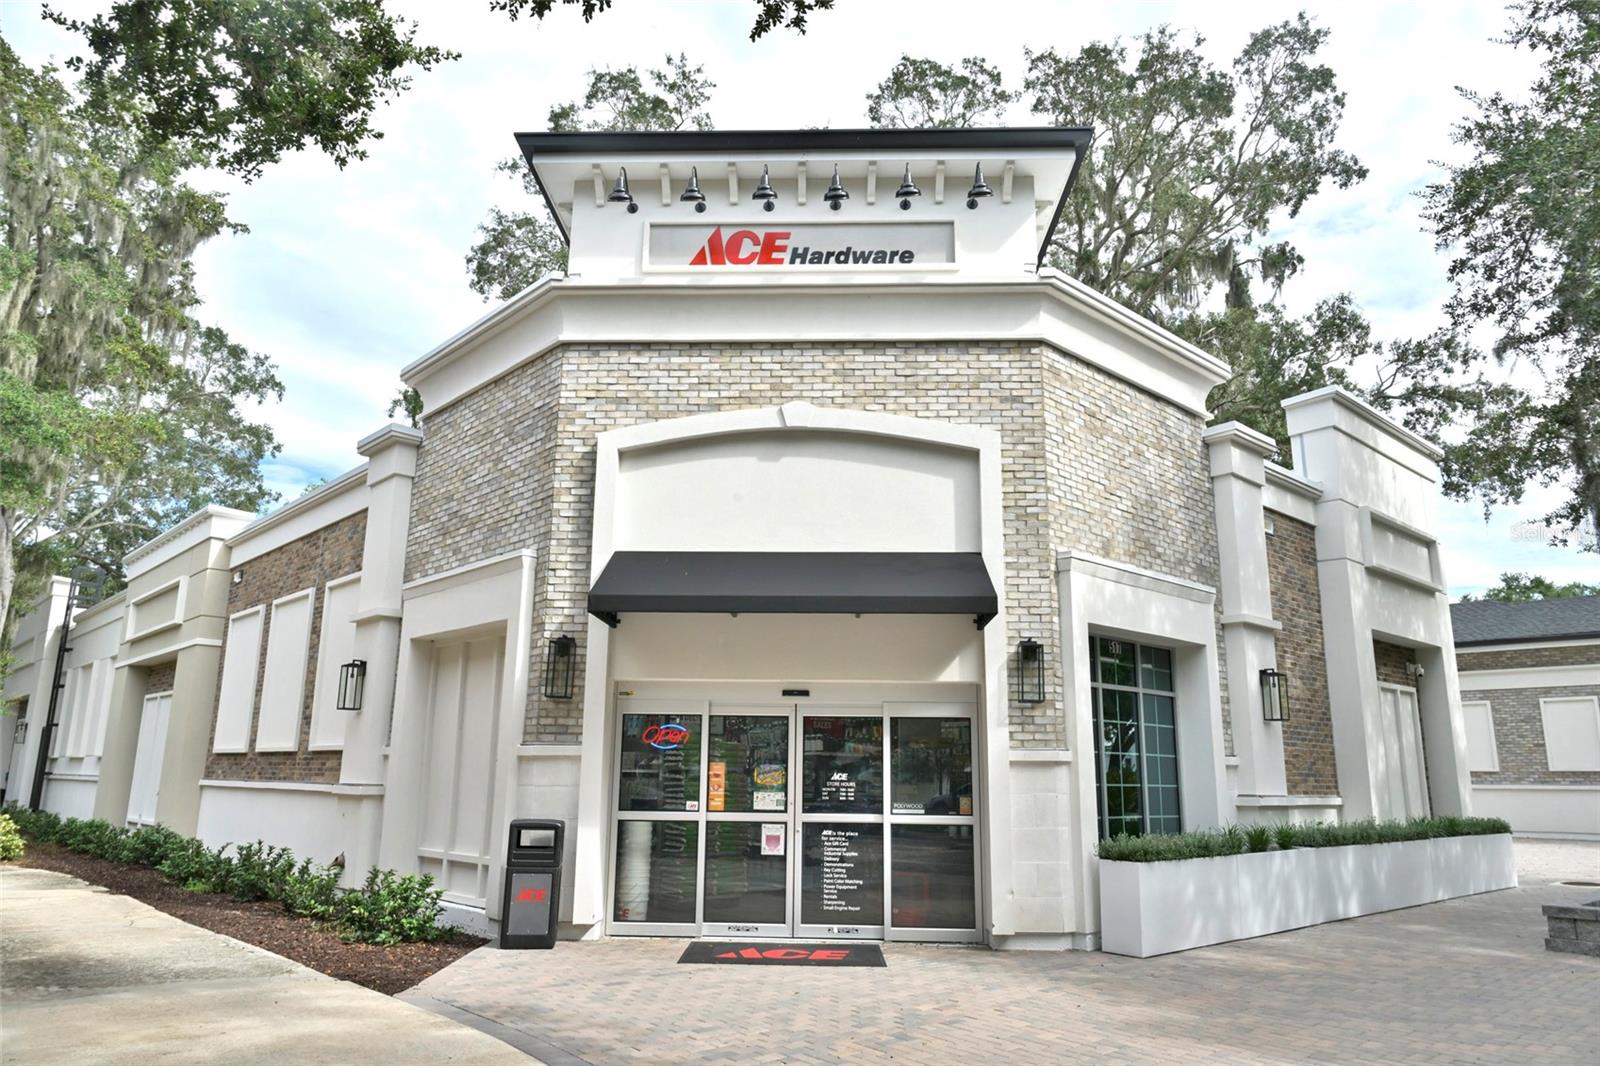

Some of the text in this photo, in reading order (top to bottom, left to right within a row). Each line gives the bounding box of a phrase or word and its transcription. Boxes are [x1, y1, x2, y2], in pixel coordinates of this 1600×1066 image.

[689, 225, 915, 265] ACE Hardware
[642, 725, 690, 745] Open
[831, 772, 848, 781] ACE
[517, 888, 546, 901] ACE
[715, 947, 849, 961] ACE
